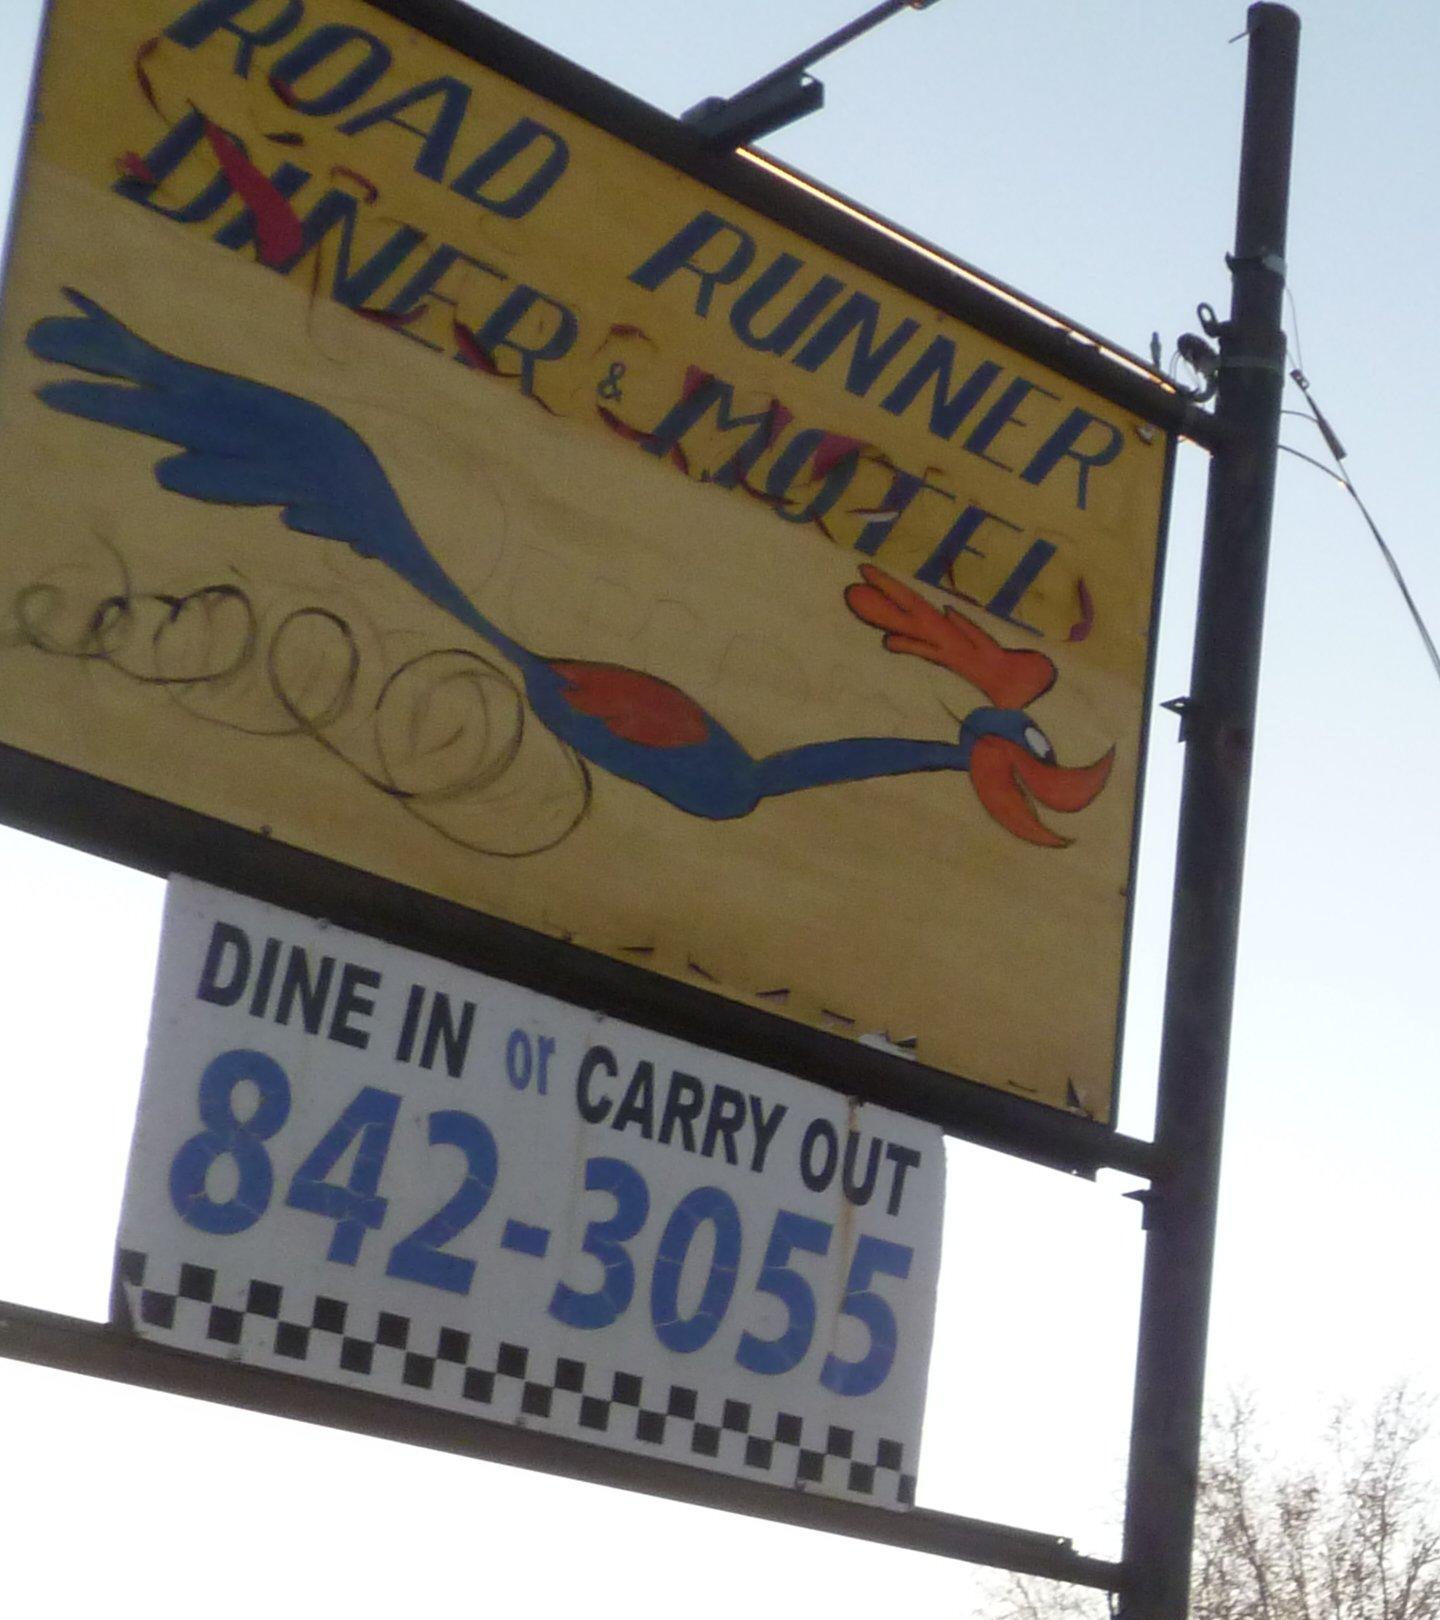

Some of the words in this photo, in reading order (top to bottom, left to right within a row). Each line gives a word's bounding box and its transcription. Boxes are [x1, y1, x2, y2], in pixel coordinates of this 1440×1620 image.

[111, 108, 578, 396] DINER
[639, 372, 1058, 638] MOTEL
[164, 0, 569, 219] ROAD
[627, 210, 1124, 510] RUNNER
[167, 1047, 915, 1398] 842-3055
[194, 919, 383, 1051] DINE
[394, 981, 477, 1080] IN
[504, 1026, 557, 1096] or
[574, 1043, 790, 1175] CARRY
[798, 1116, 921, 1216] OUT
